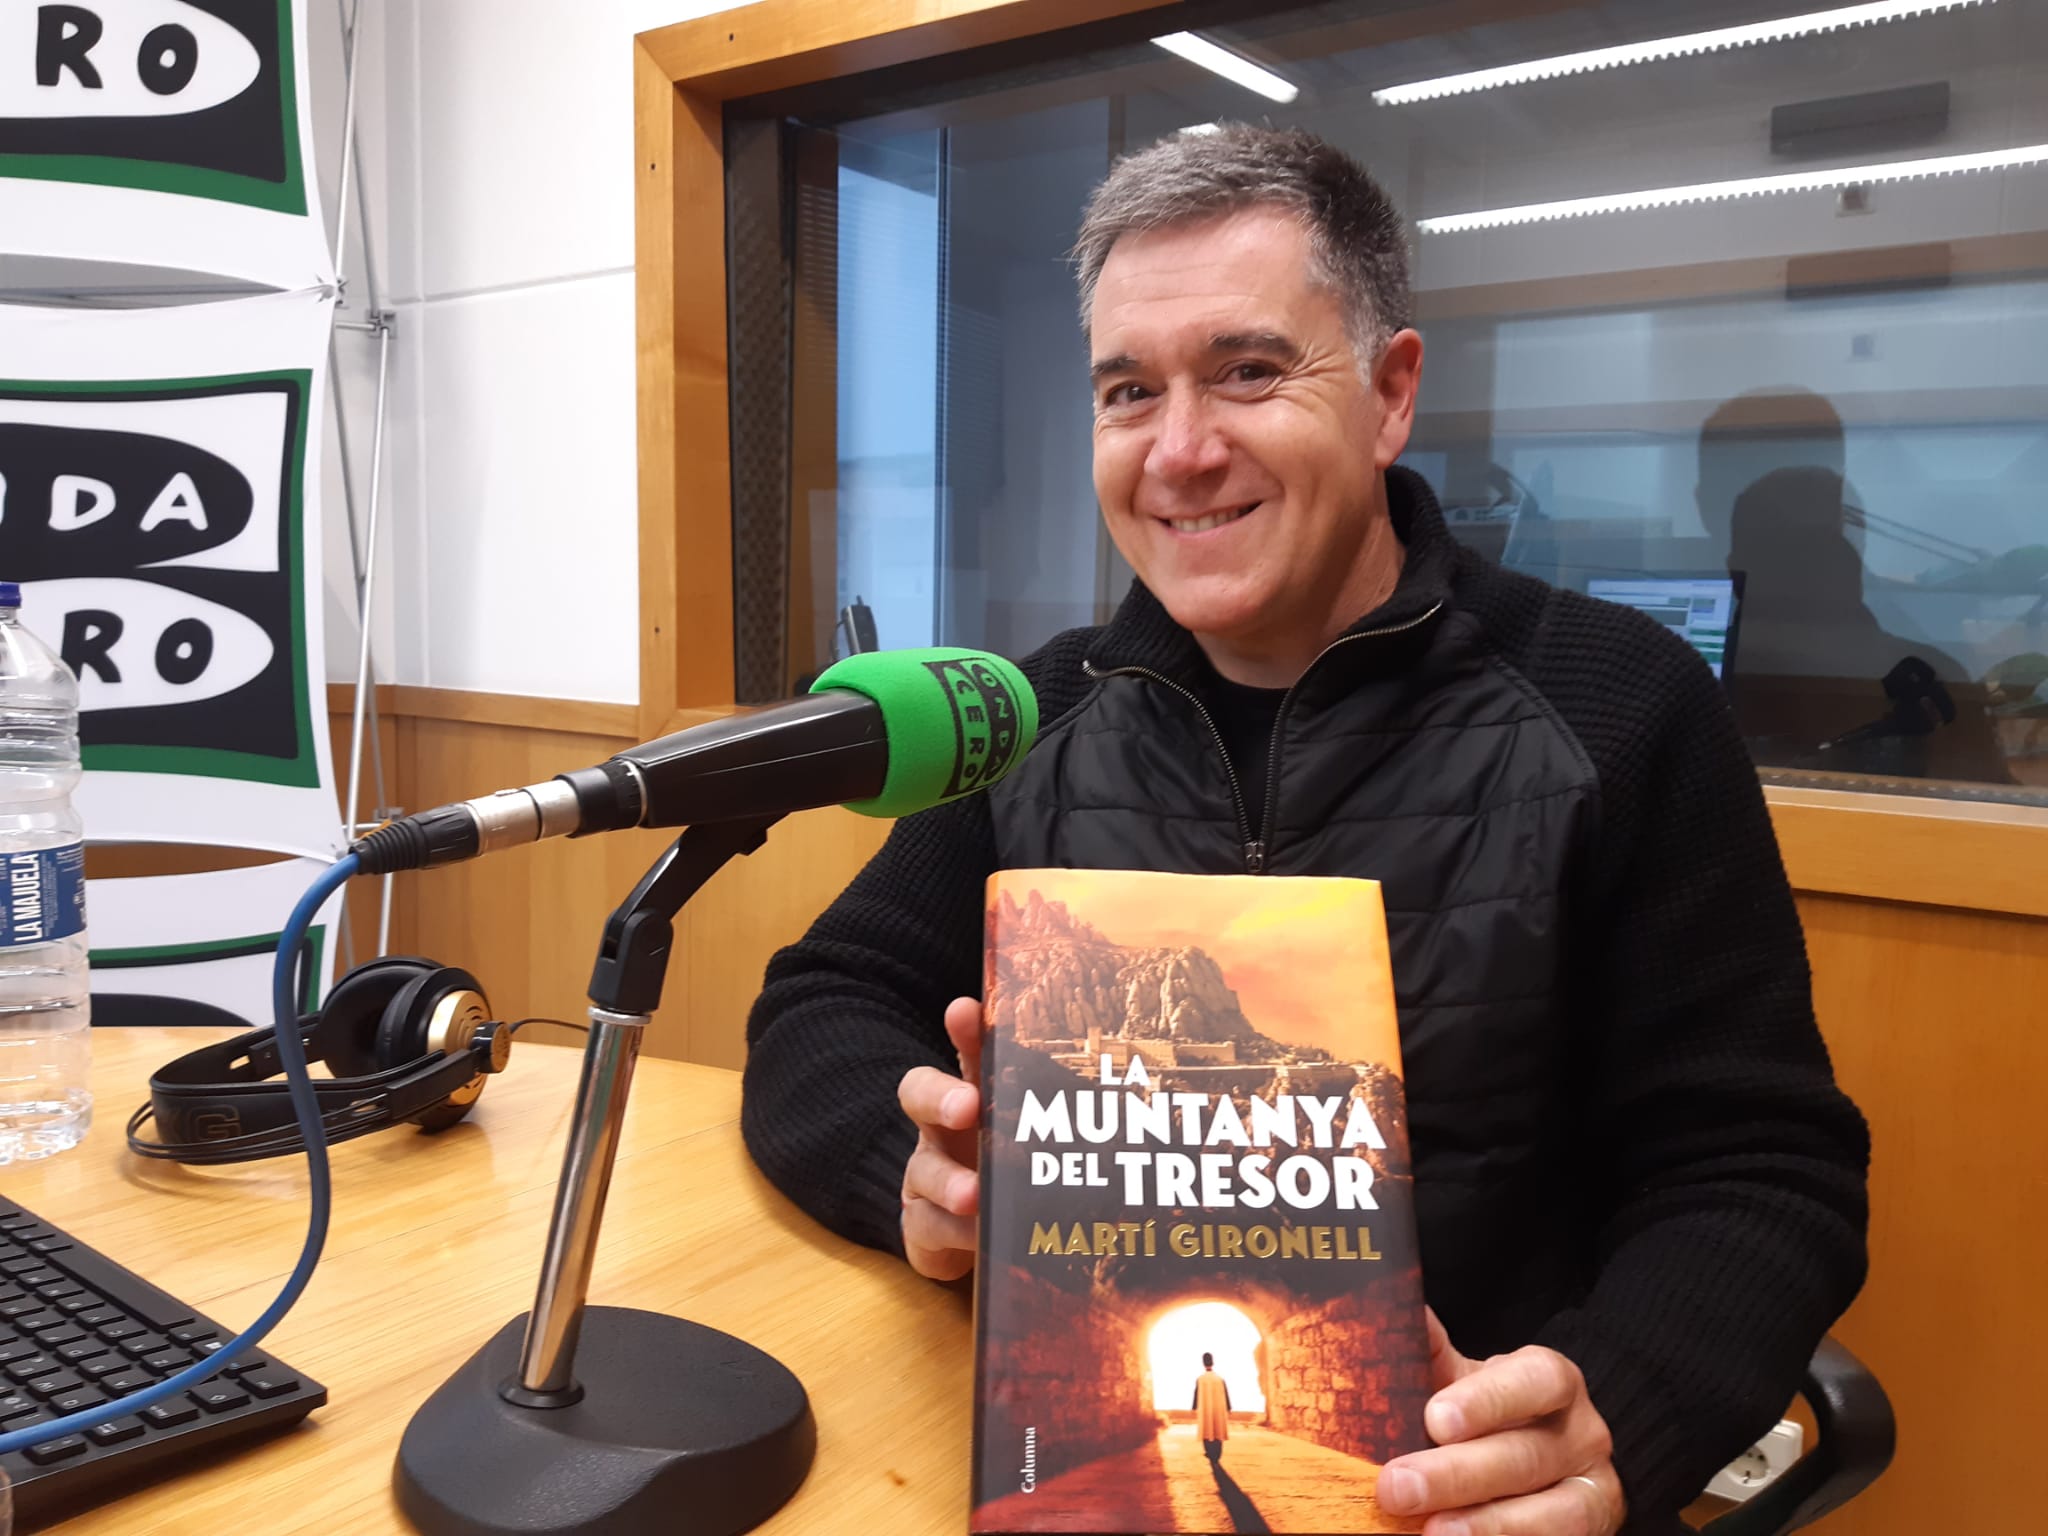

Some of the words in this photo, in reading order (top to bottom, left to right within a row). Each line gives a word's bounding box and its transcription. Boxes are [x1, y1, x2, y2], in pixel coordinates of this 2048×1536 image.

[0, 471, 208, 532] DA
[956, 679, 986, 778] CERO
[10, 853, 42, 921] MAJUELA
[14, 920, 43, 941] LA
[1099, 1053, 1152, 1087] LA
[1014, 1088, 1388, 1150] MUNTANYA
[1031, 1151, 1109, 1187] DEL
[1115, 1151, 1380, 1211] TRESOR
[1028, 1218, 1157, 1258] MARTÍ
[1168, 1222, 1383, 1261] GIRONELL
[1020, 1426, 1037, 1494] Columna
